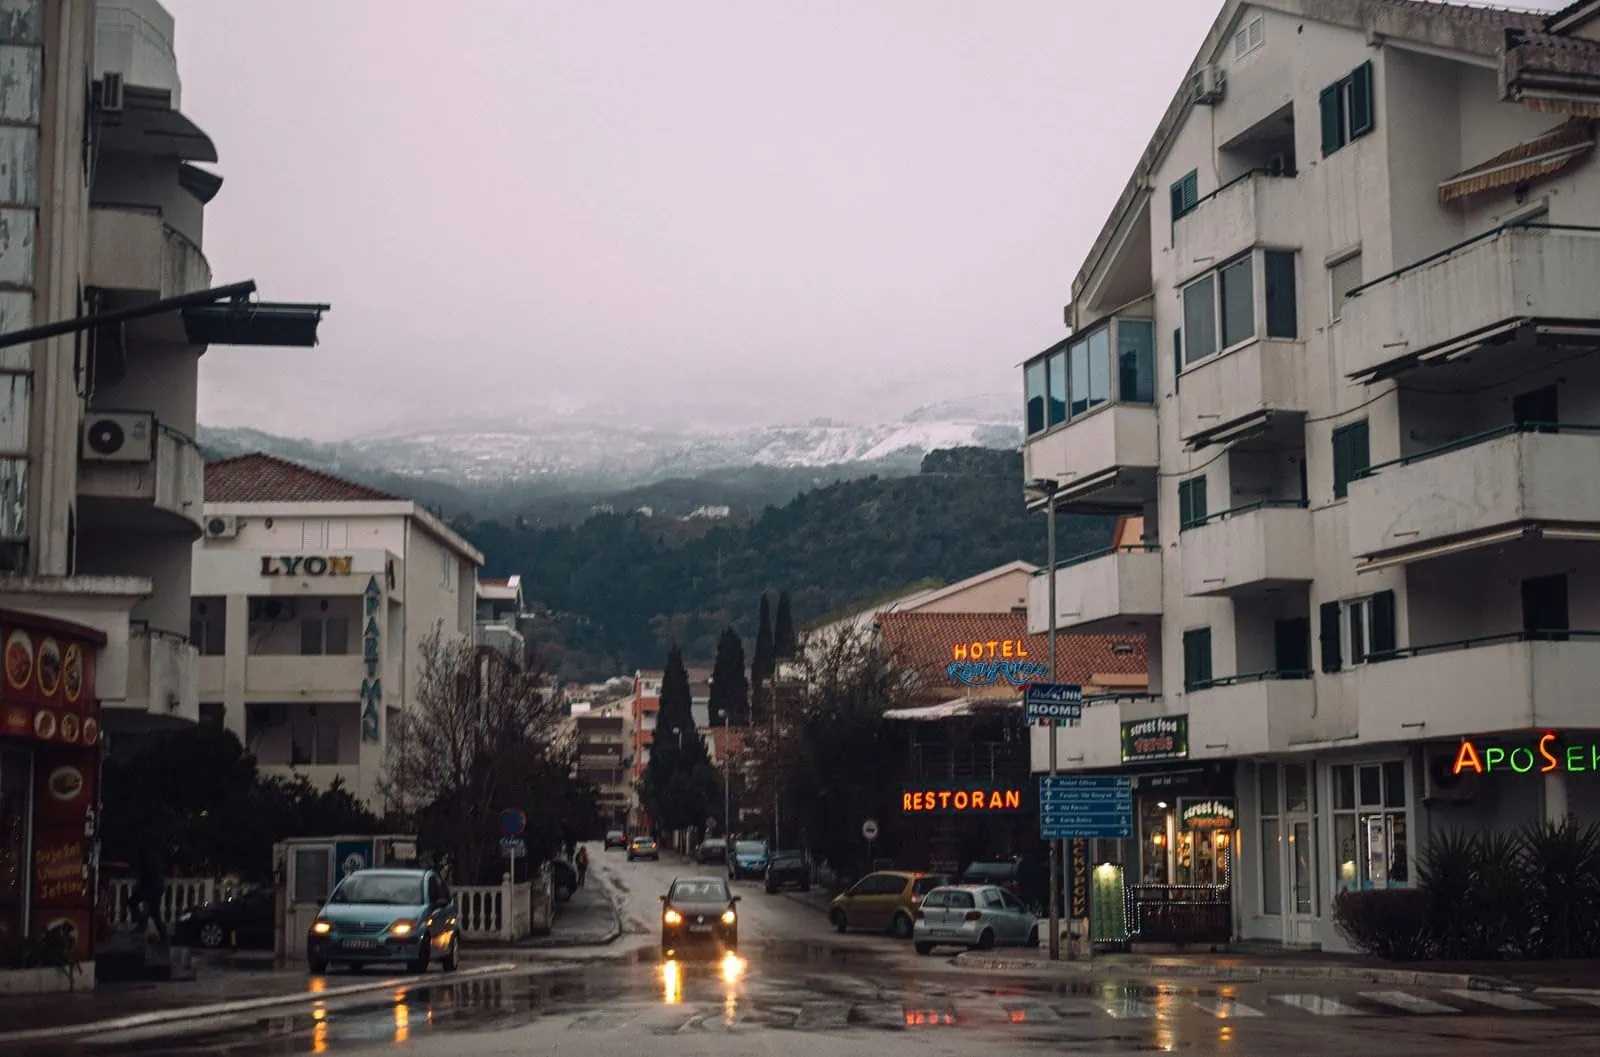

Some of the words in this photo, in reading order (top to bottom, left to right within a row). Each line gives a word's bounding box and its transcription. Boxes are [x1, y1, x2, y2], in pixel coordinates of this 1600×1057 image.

[261, 555, 353, 577] LYON
[360, 574, 383, 742] APARTMAN
[953, 639, 1029, 660] HOTEL
[1028, 703, 1081, 716] ROOMS
[903, 790, 1020, 810] RESTORAN
